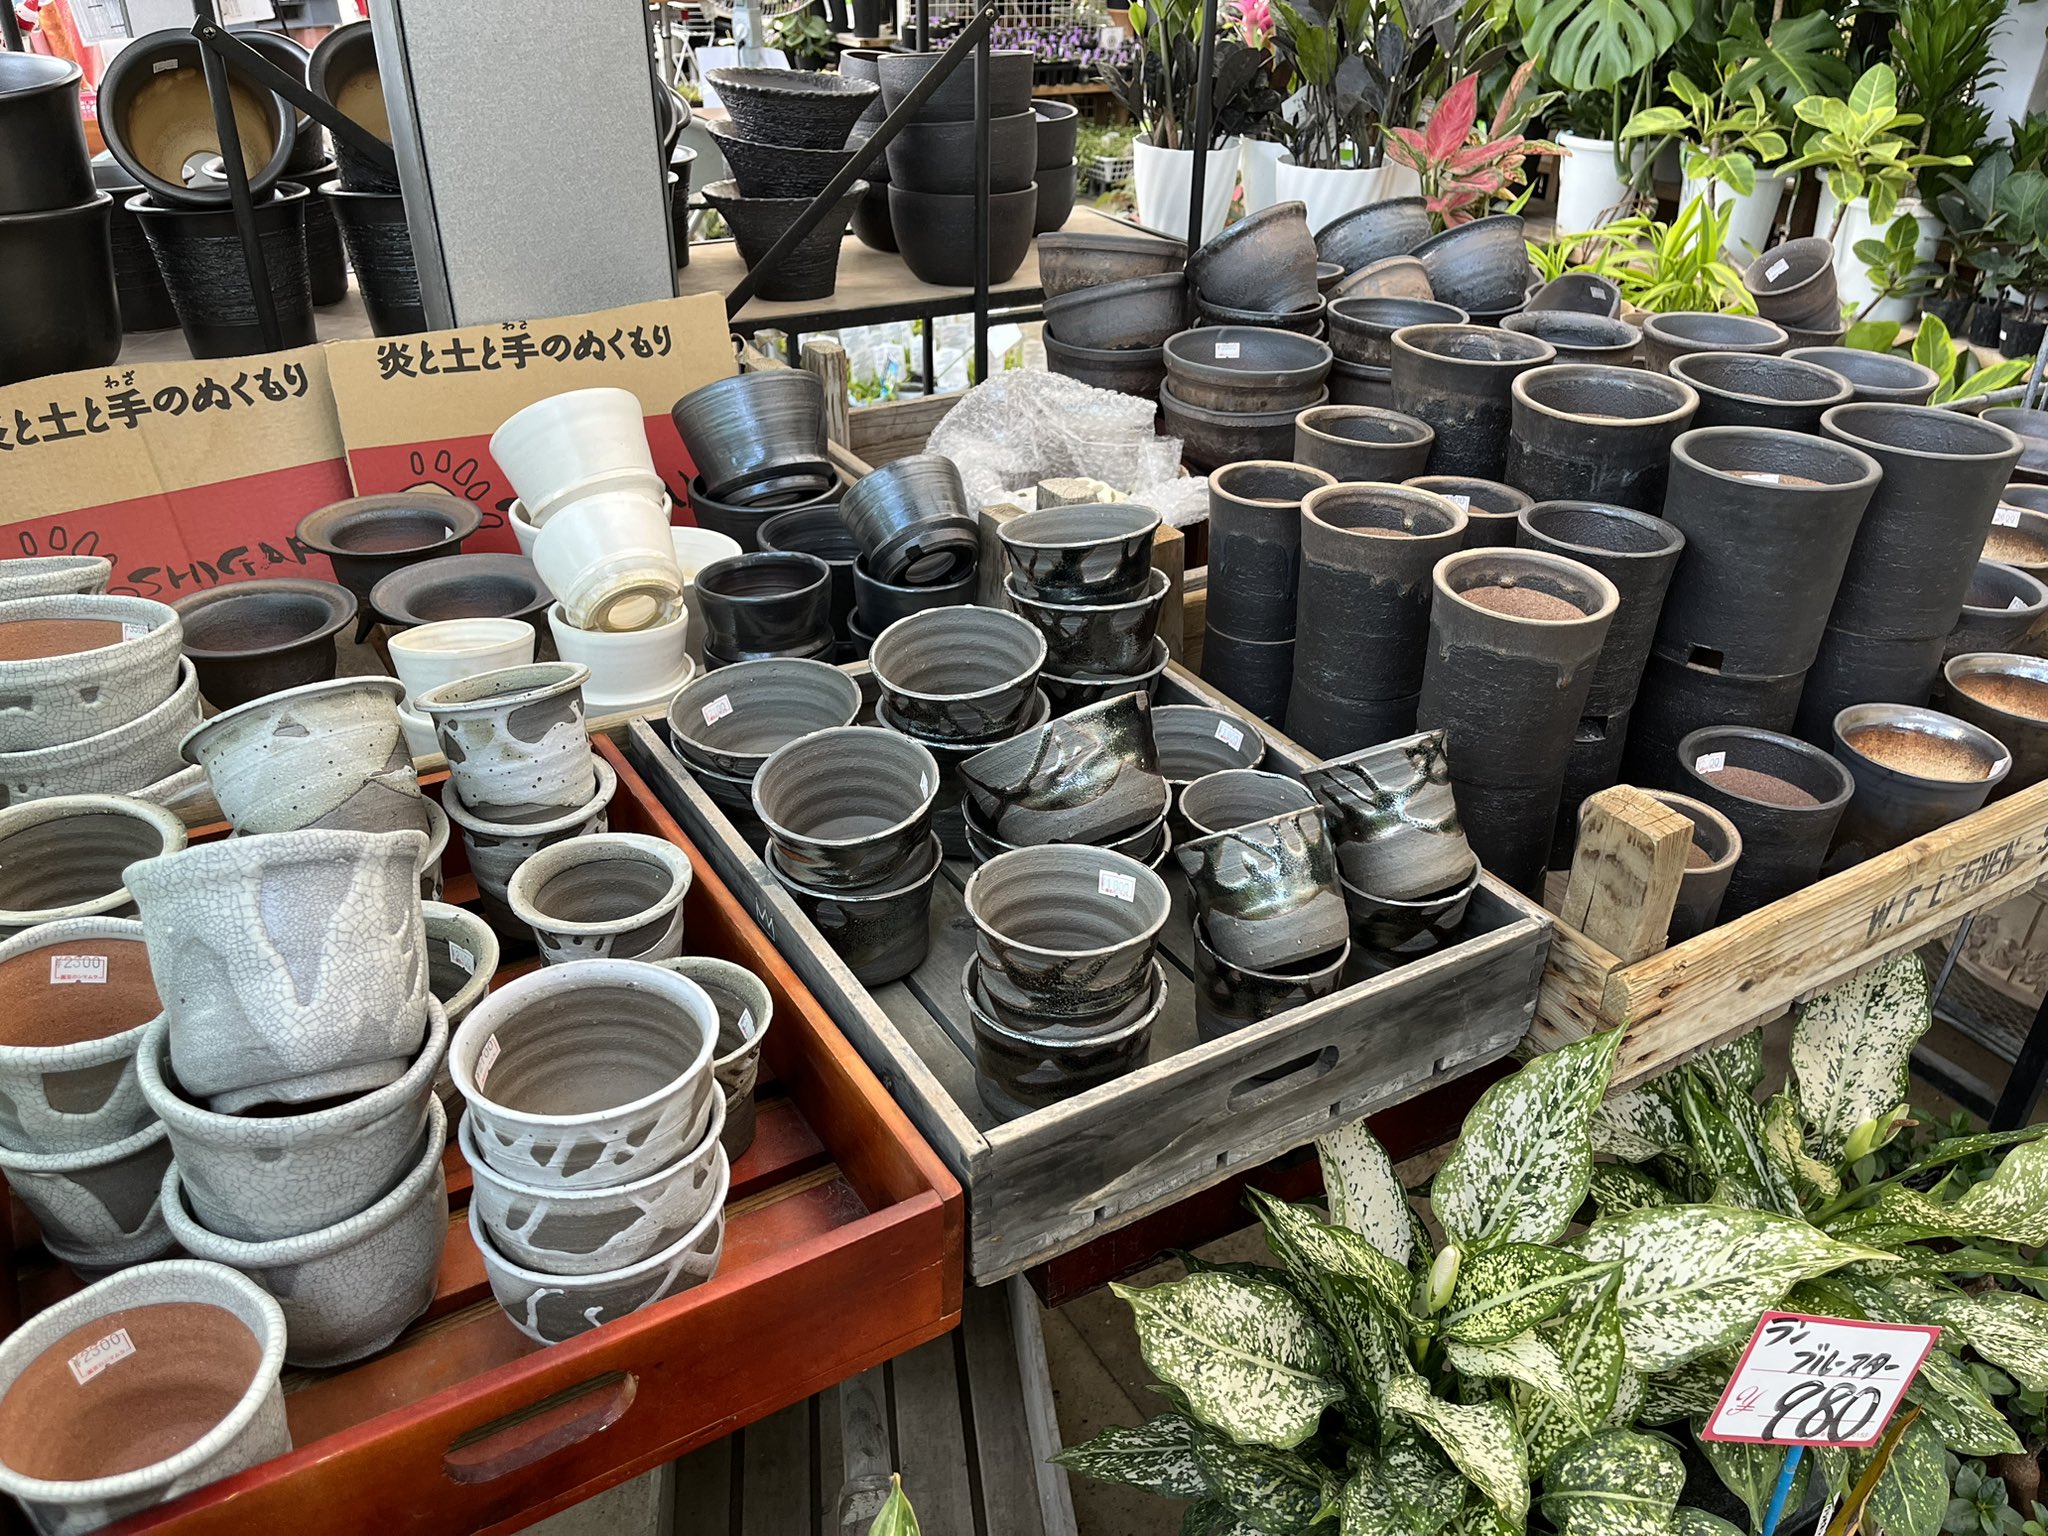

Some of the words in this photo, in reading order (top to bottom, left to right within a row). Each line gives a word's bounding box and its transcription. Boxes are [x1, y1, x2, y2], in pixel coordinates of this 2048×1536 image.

[377, 325, 673, 380] 炎と土と手のぬくもり
[1761, 1380, 1881, 1442] 980
